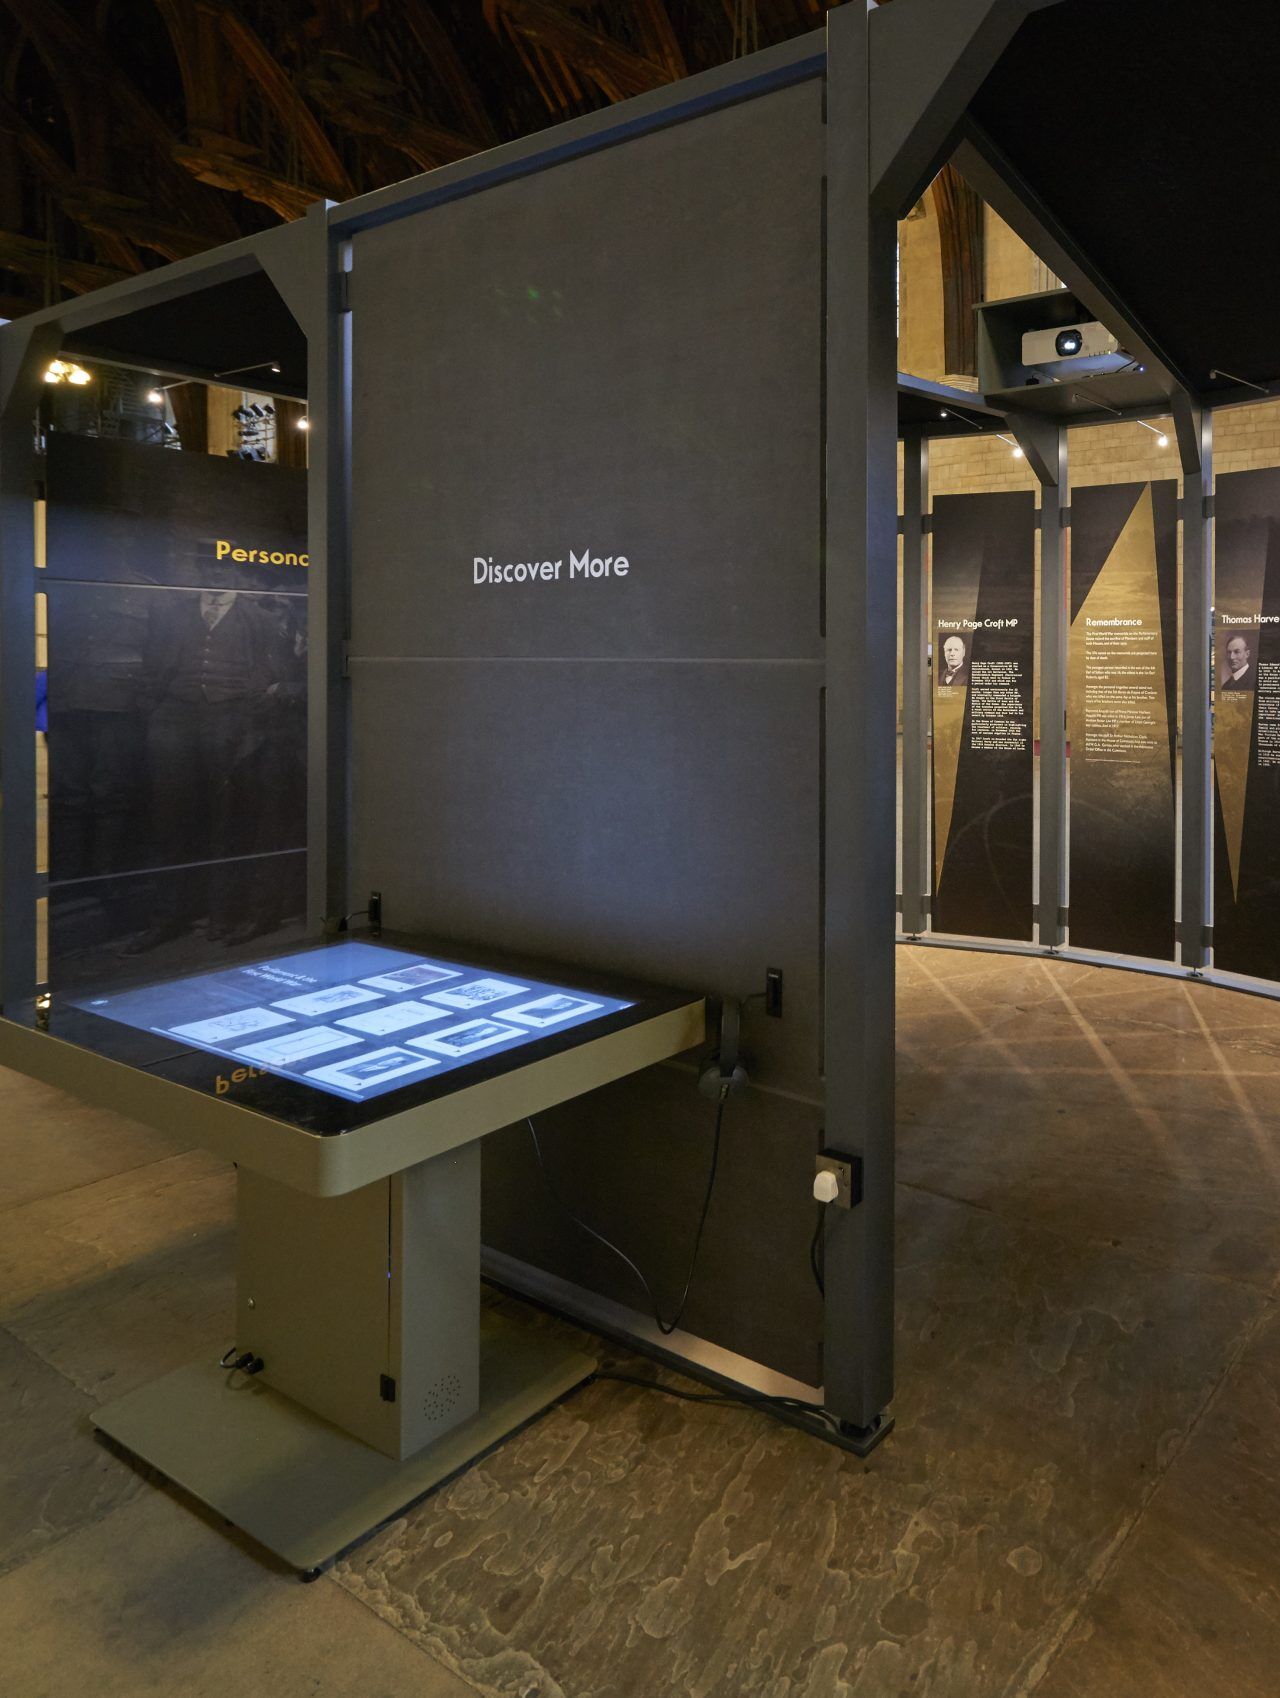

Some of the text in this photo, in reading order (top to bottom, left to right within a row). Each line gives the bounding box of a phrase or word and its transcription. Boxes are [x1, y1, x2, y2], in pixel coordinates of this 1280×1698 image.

[474, 549, 629, 584] Discover More
[1086, 618, 1142, 626] Remembrance
[1222, 614, 1252, 623] Thomas
[938, 618, 1018, 630] Henry Page Croft MP
